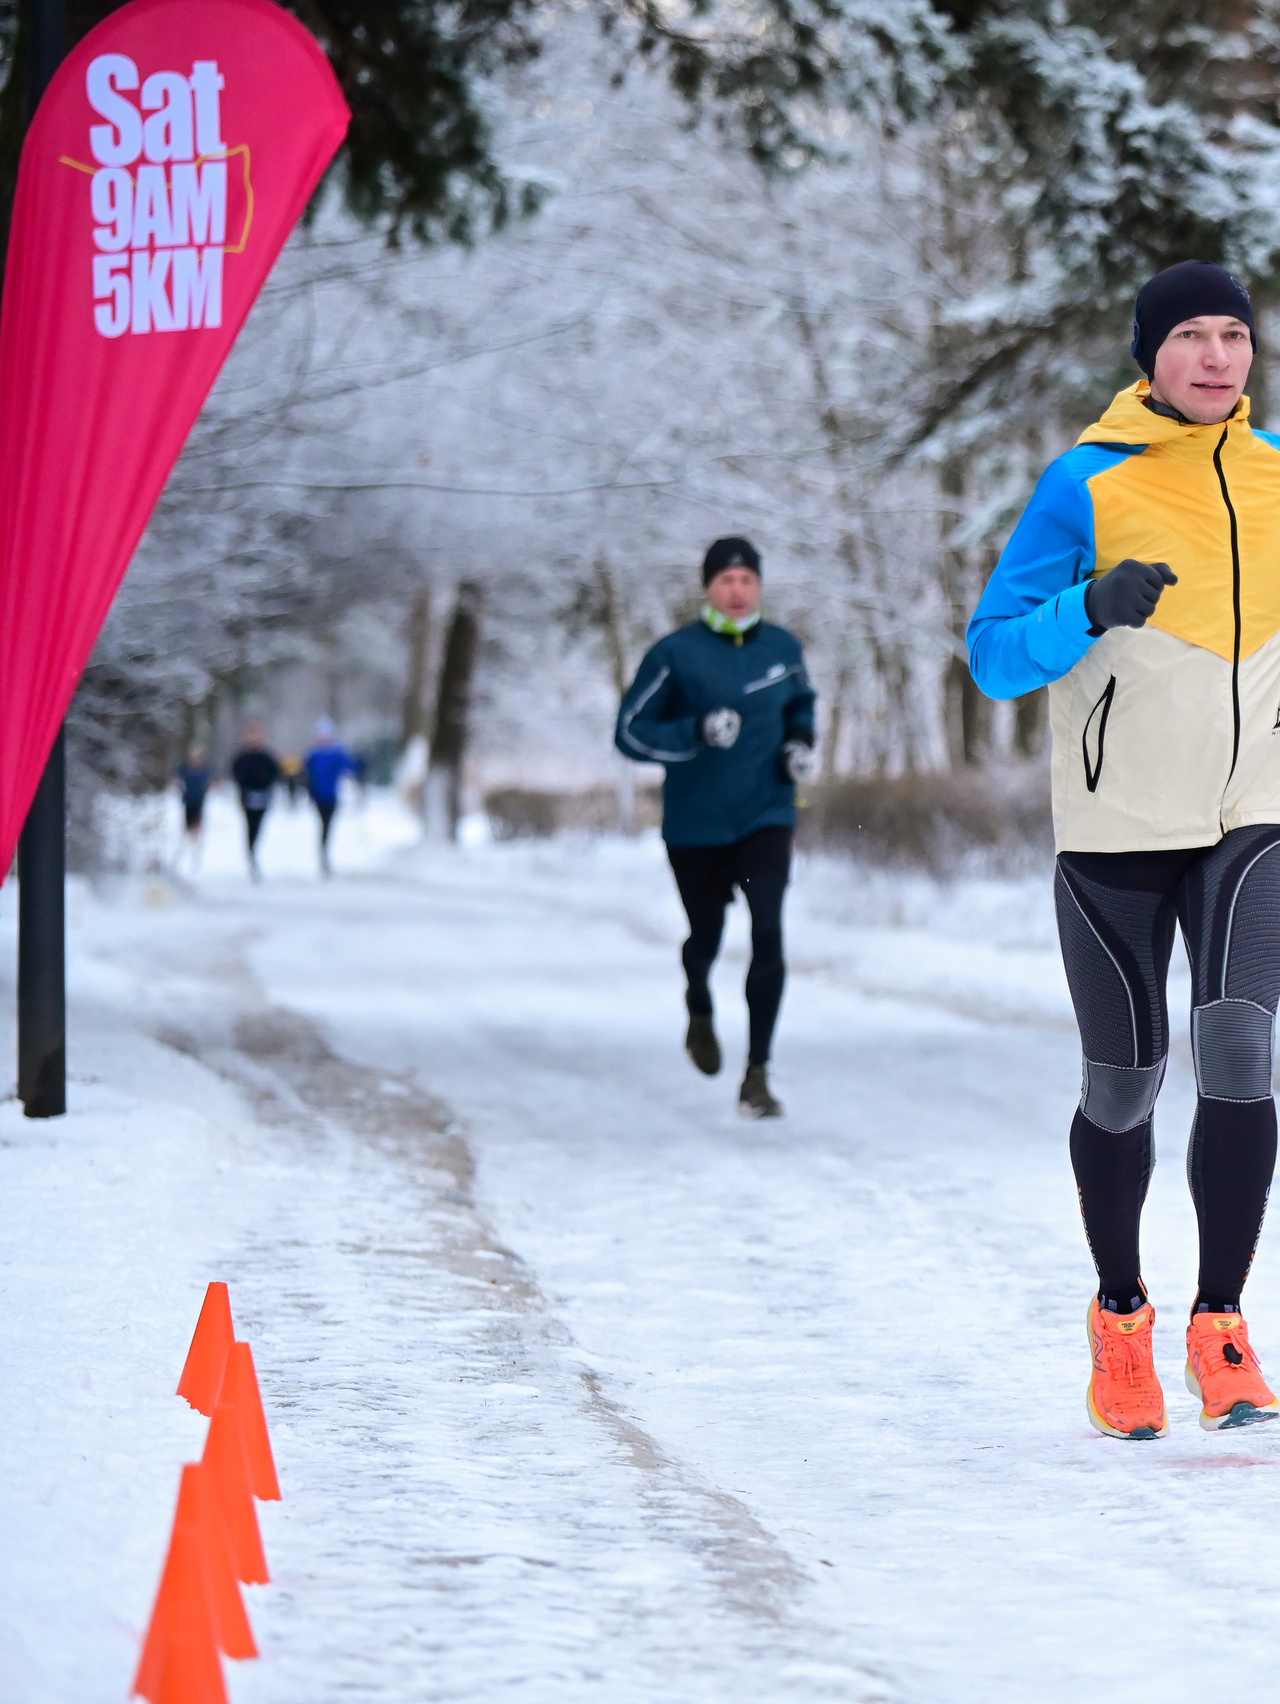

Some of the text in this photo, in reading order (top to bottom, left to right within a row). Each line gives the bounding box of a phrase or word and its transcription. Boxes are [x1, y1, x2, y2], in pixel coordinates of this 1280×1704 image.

[86, 53, 226, 167] Sat
[90, 163, 228, 251] 9AM
[92, 246, 225, 338] 5KM
